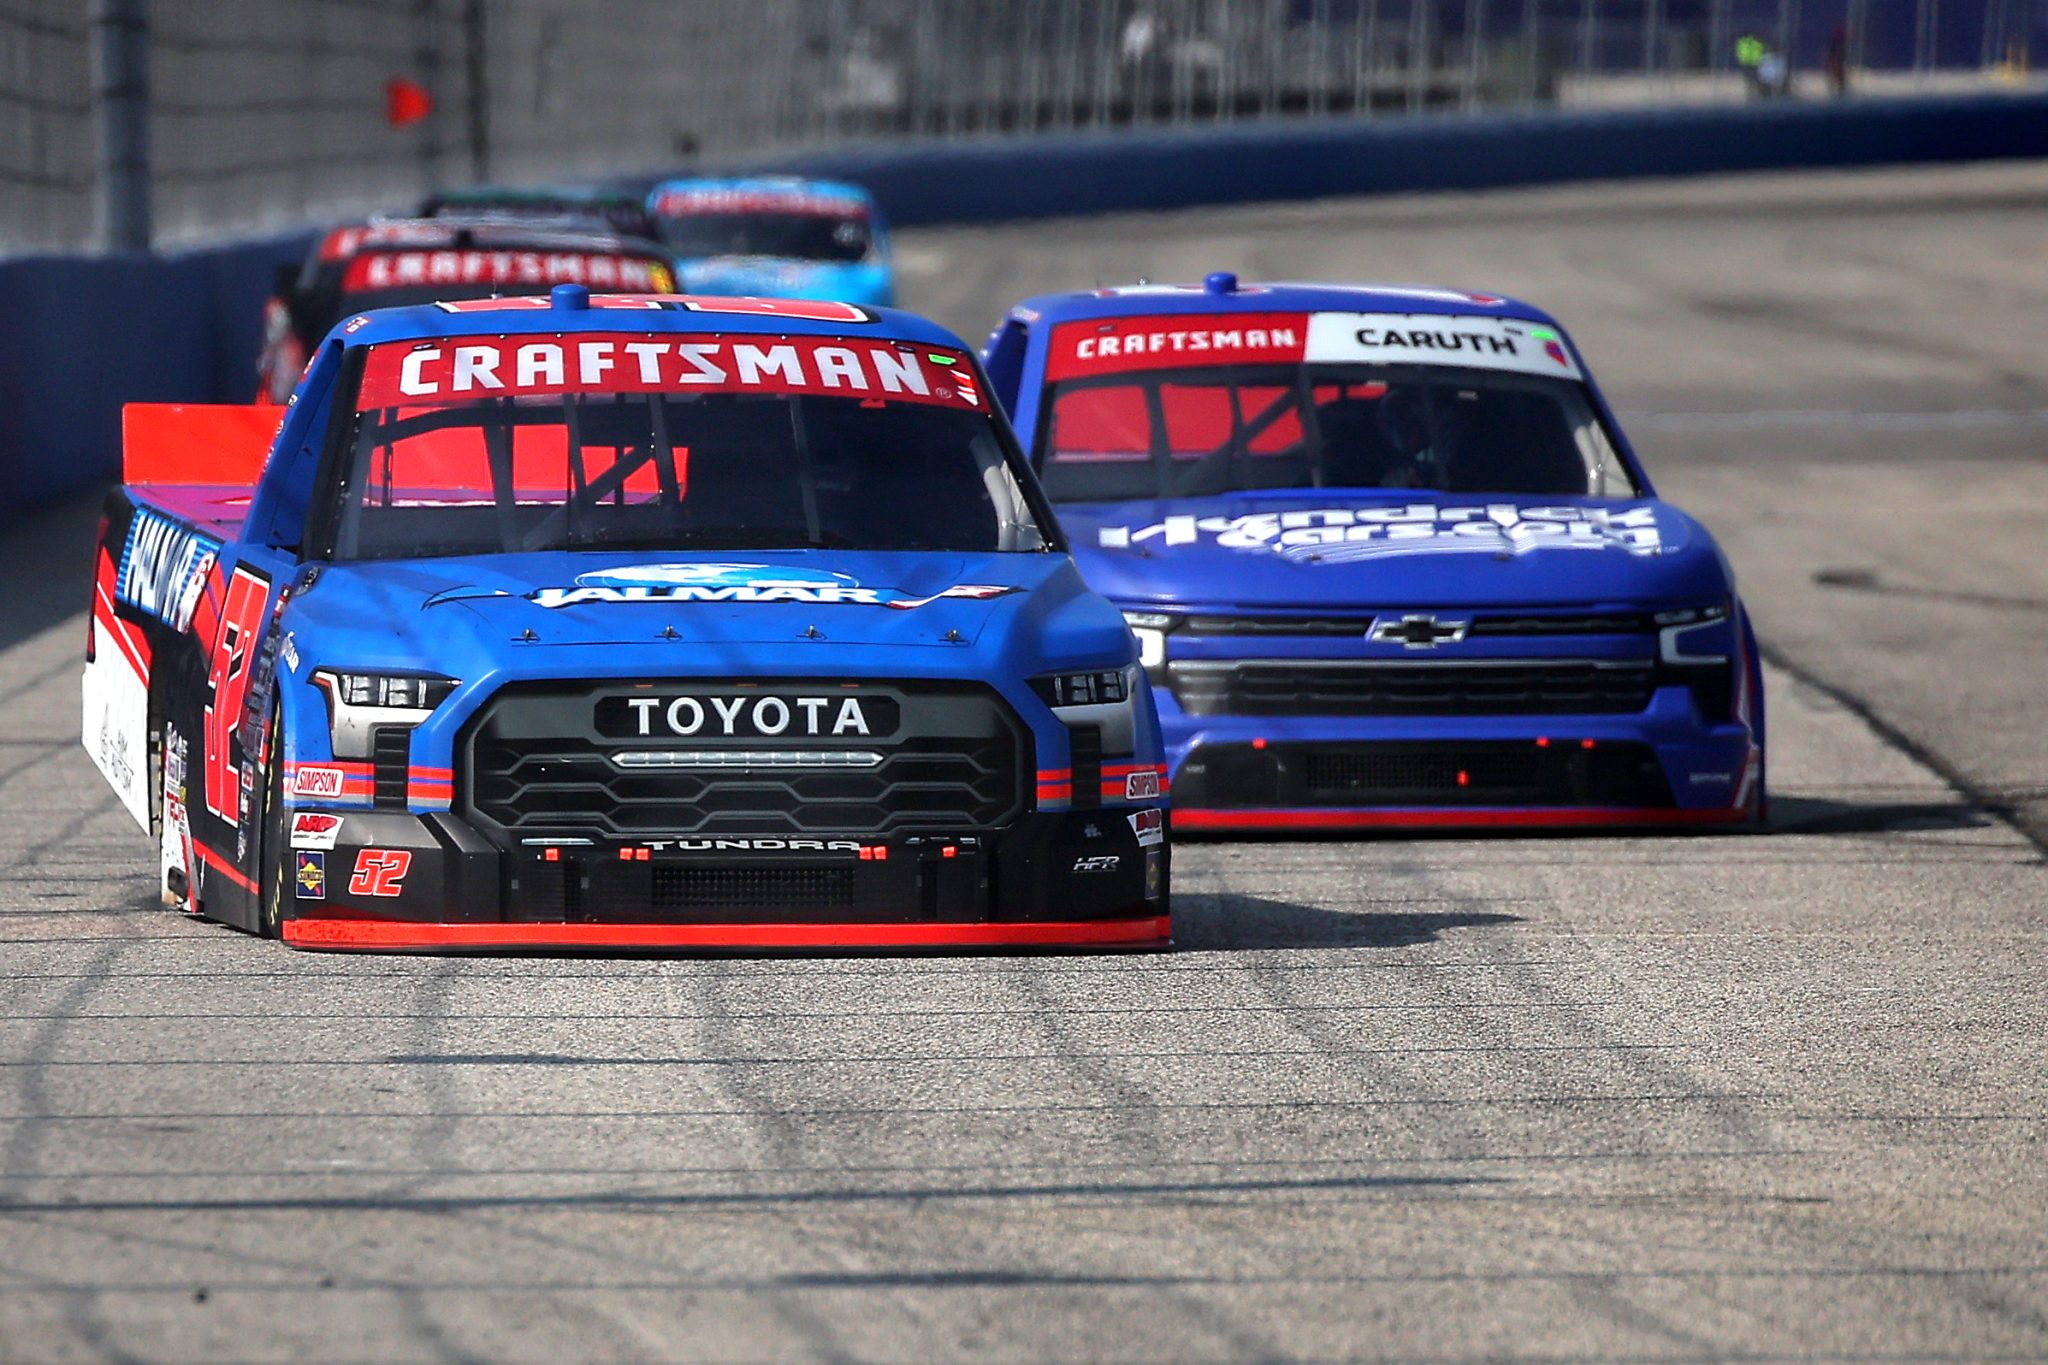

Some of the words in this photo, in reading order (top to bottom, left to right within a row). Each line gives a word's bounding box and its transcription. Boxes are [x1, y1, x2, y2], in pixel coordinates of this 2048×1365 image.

[1076, 327, 1296, 360] CRAFTSMAN
[1356, 327, 1519, 356] CARUTH
[400, 343, 931, 397] CRAFTSMAN
[628, 696, 870, 736] TOYOTA
[296, 770, 338, 793] SIMPSON
[294, 815, 338, 832] ARP
[642, 839, 861, 851] TUNDRA
[348, 848, 412, 897] 52
[1073, 856, 1120, 871] HFR
